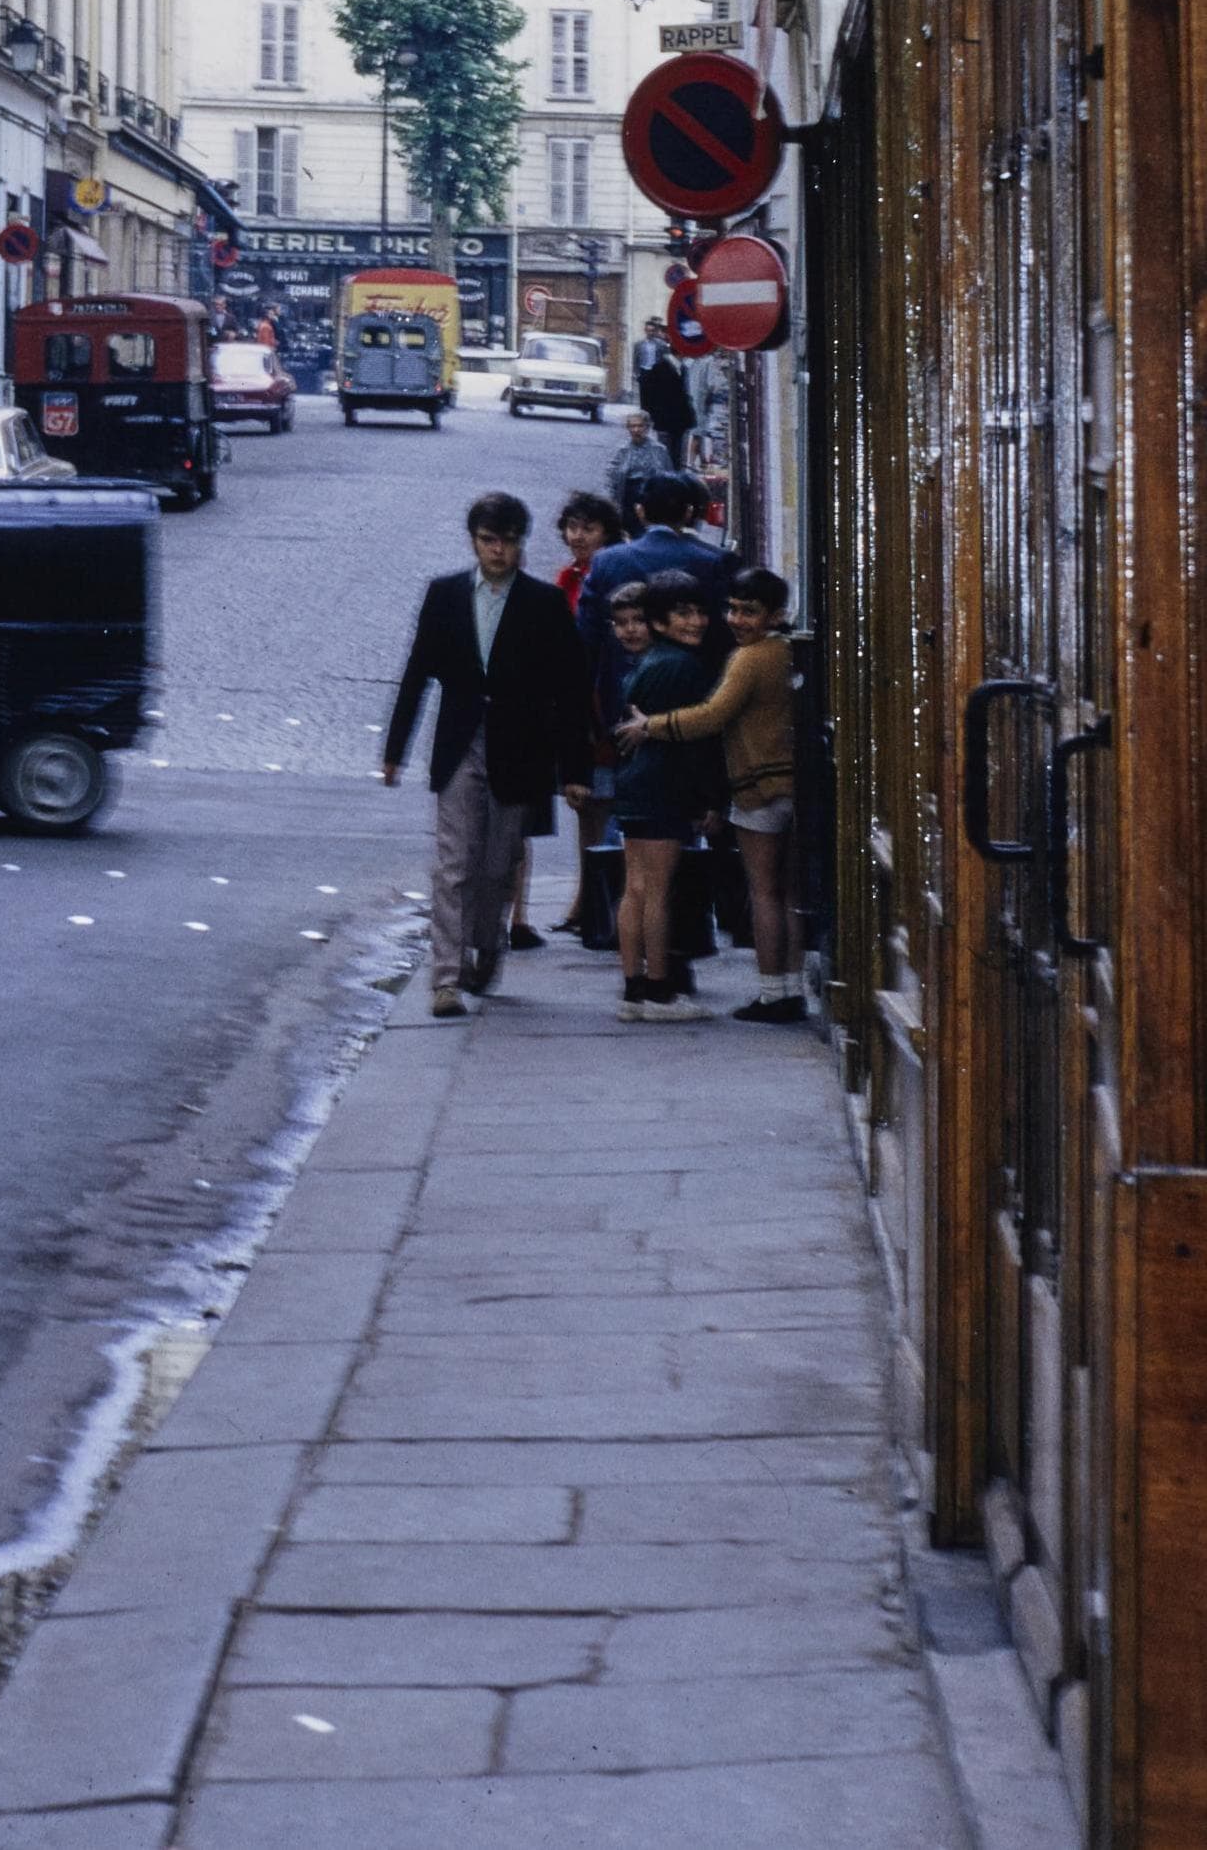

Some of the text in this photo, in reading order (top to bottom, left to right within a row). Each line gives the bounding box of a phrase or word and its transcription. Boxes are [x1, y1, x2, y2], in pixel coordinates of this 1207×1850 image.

[661, 26, 738, 48] RAPPEL
[248, 232, 484, 256] TERIEL PHOO
[276, 270, 309, 282] ACHAT
